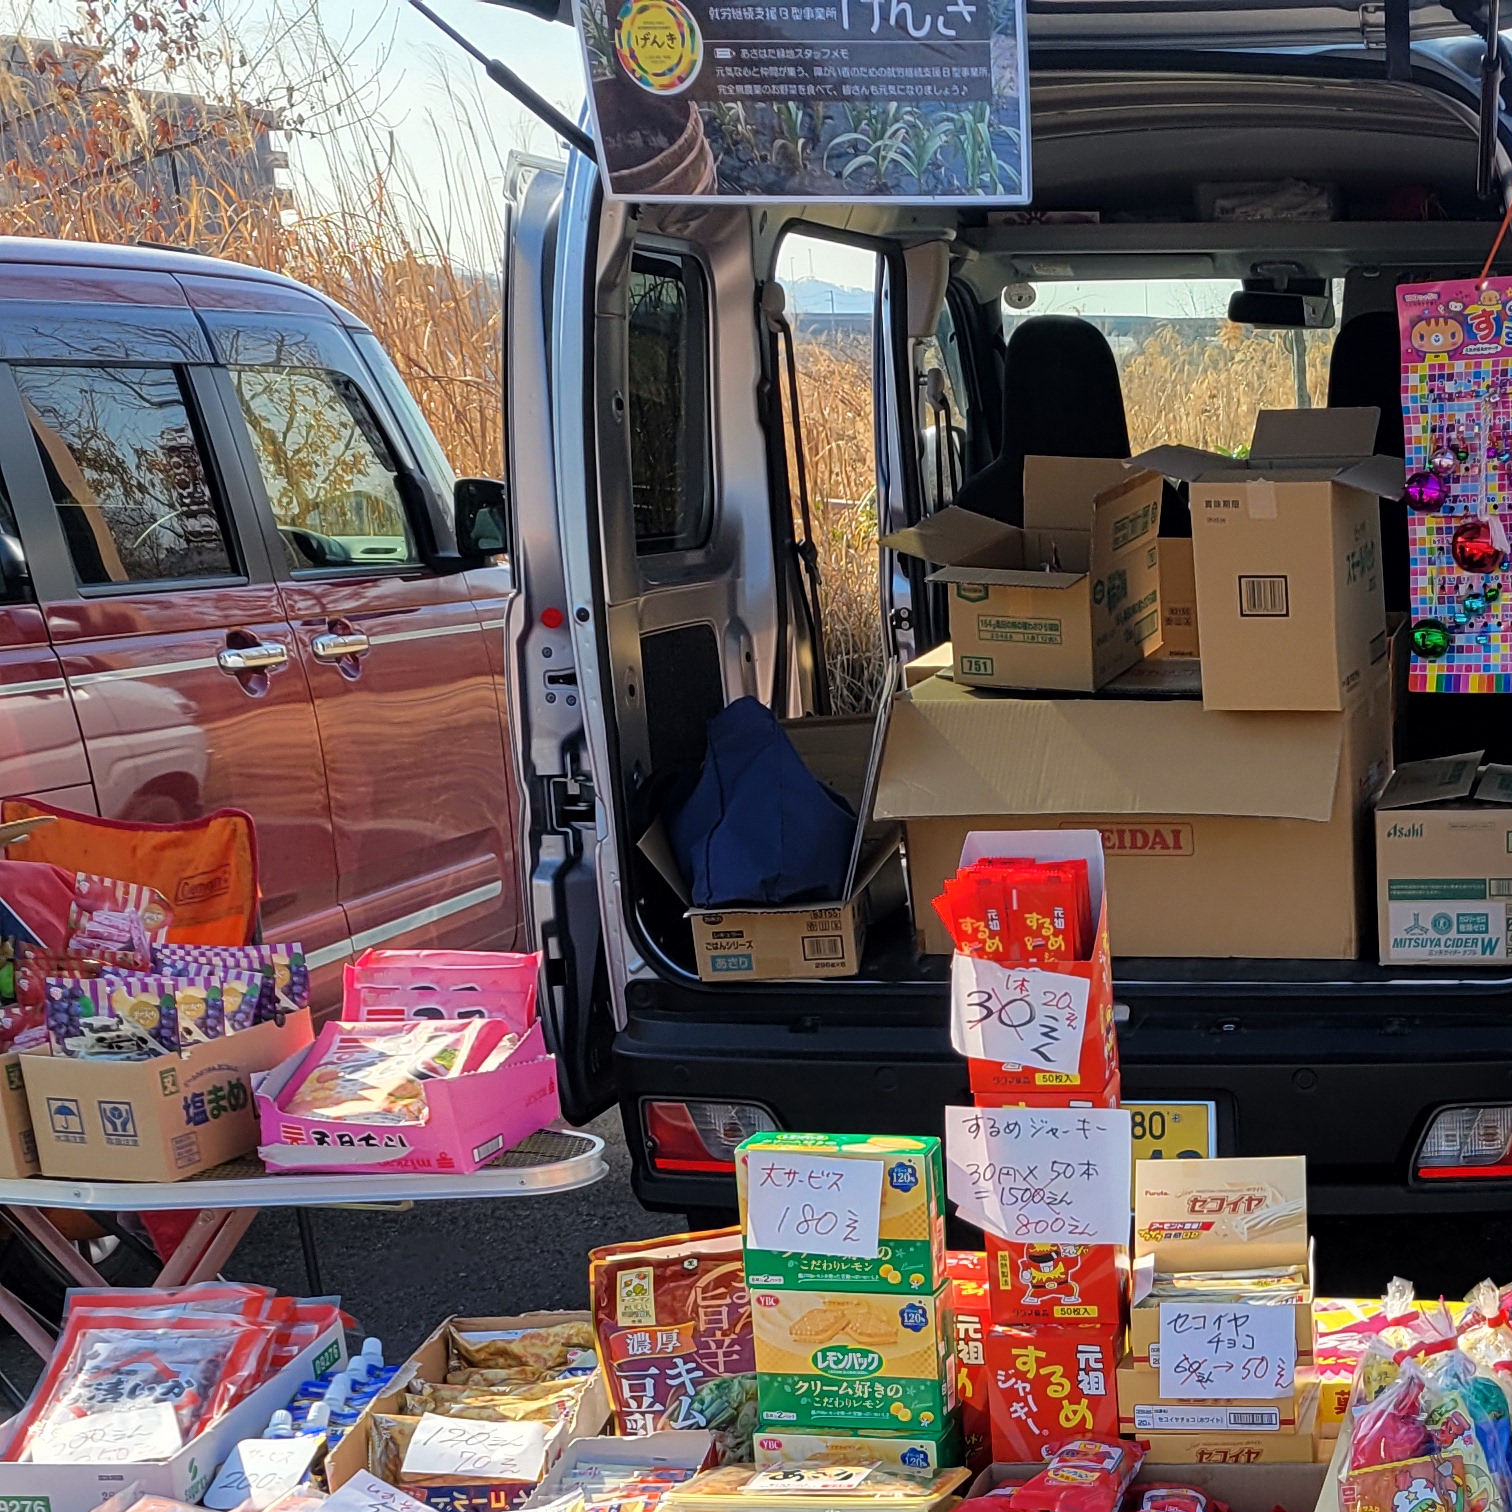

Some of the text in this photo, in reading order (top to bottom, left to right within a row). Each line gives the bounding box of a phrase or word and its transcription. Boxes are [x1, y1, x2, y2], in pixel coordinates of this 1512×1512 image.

[635, 31, 677, 49] げんき
[1204, 500, 1240, 510] 賞味期限
[967, 659, 988, 674] 751
[1386, 822, 1424, 838] Asahi
[705, 940, 754, 951] ごはんシリーズ
[1392, 936, 1500, 956] MITSUYA CIDER W
[716, 956, 749, 969] あさり
[1041, 1073, 1073, 1085] 50枚入
[182, 1077, 249, 1127] 塩まめ
[961, 1115, 1107, 1140] するめジャーキー
[1131, 1110, 1166, 1140] 80
[760, 1162, 845, 1192] 大サービス
[1187, 1194, 1267, 1216] セコイヤ
[1014, 1213, 1099, 1238] 800えん
[799, 1260, 874, 1272] こだわりレモン
[759, 1296, 777, 1307] YBC
[1060, 1307, 1091, 1316] 50枚入
[696, 1287, 742, 1373] 旨辛
[1167, 1312, 1251, 1334] セコイヤ
[625, 1328, 681, 1356] 濃厚
[956, 1314, 986, 1366] 元祖
[1207, 1333, 1256, 1355] チョコ
[816, 1350, 880, 1371] レモンパック
[1076, 1343, 1108, 1397] 元祖
[665, 1357, 707, 1430] キム
[794, 1380, 903, 1399] クリーム好きの
[1011, 1345, 1094, 1431] するめ
[615, 1366, 665, 1436] 豆乳
[812, 1398, 885, 1409] こだわりレモン
[996, 1368, 1041, 1436] ジャーキー
[761, 1439, 780, 1450] YBC
[1196, 1447, 1264, 1464] セコイヤ
